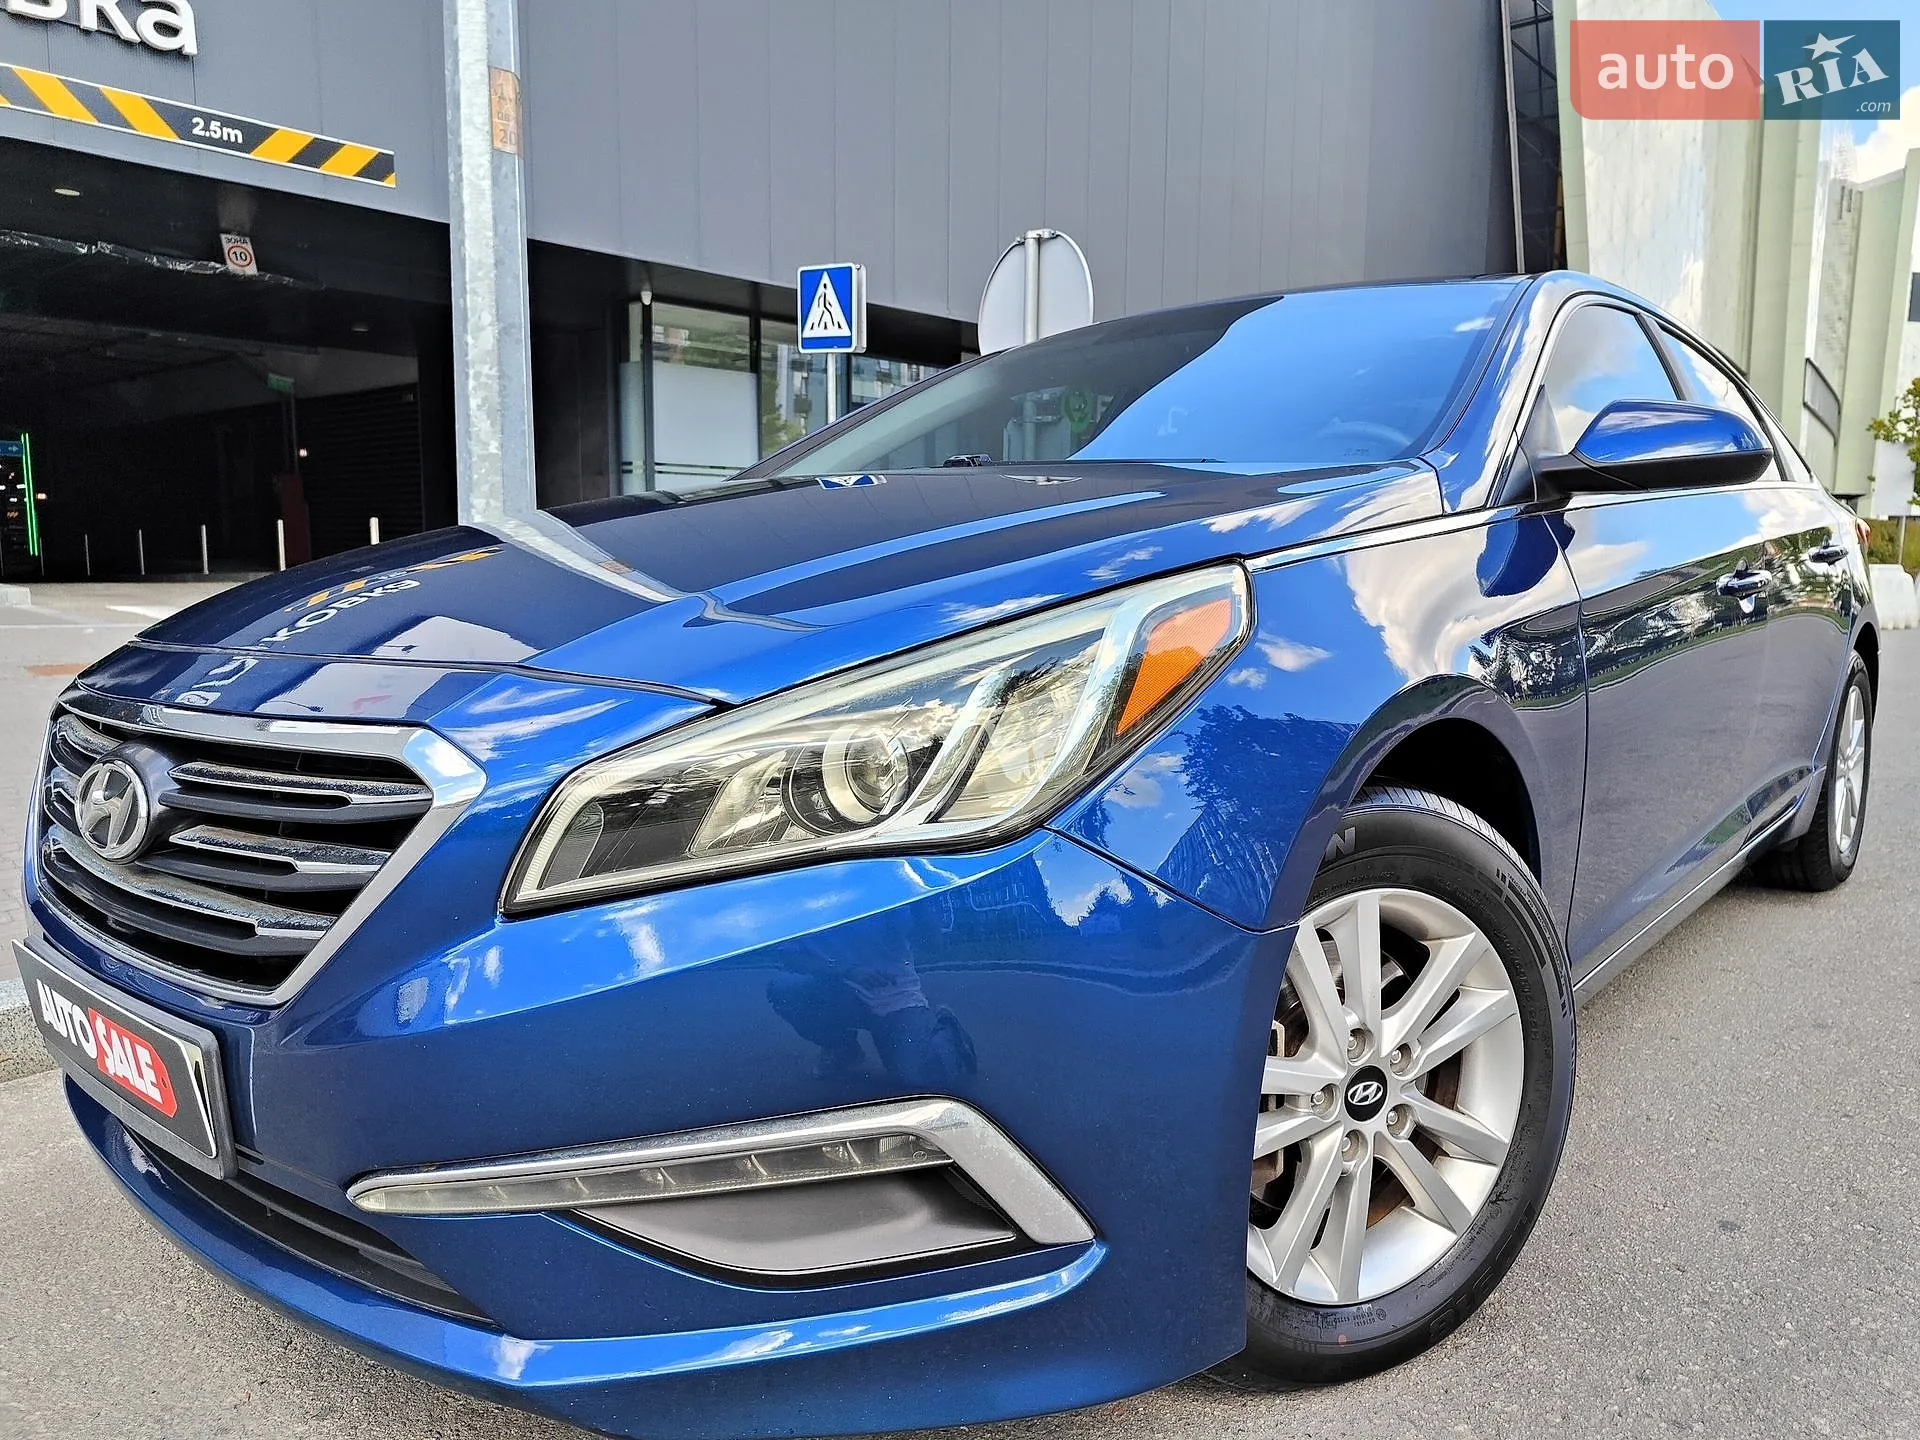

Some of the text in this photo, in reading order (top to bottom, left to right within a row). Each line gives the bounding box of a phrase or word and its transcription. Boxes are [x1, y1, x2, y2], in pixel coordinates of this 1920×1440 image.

[191, 116, 243, 144] 2.5m
[232, 251, 248, 261] 10
[36, 978, 98, 1060] AUTO
